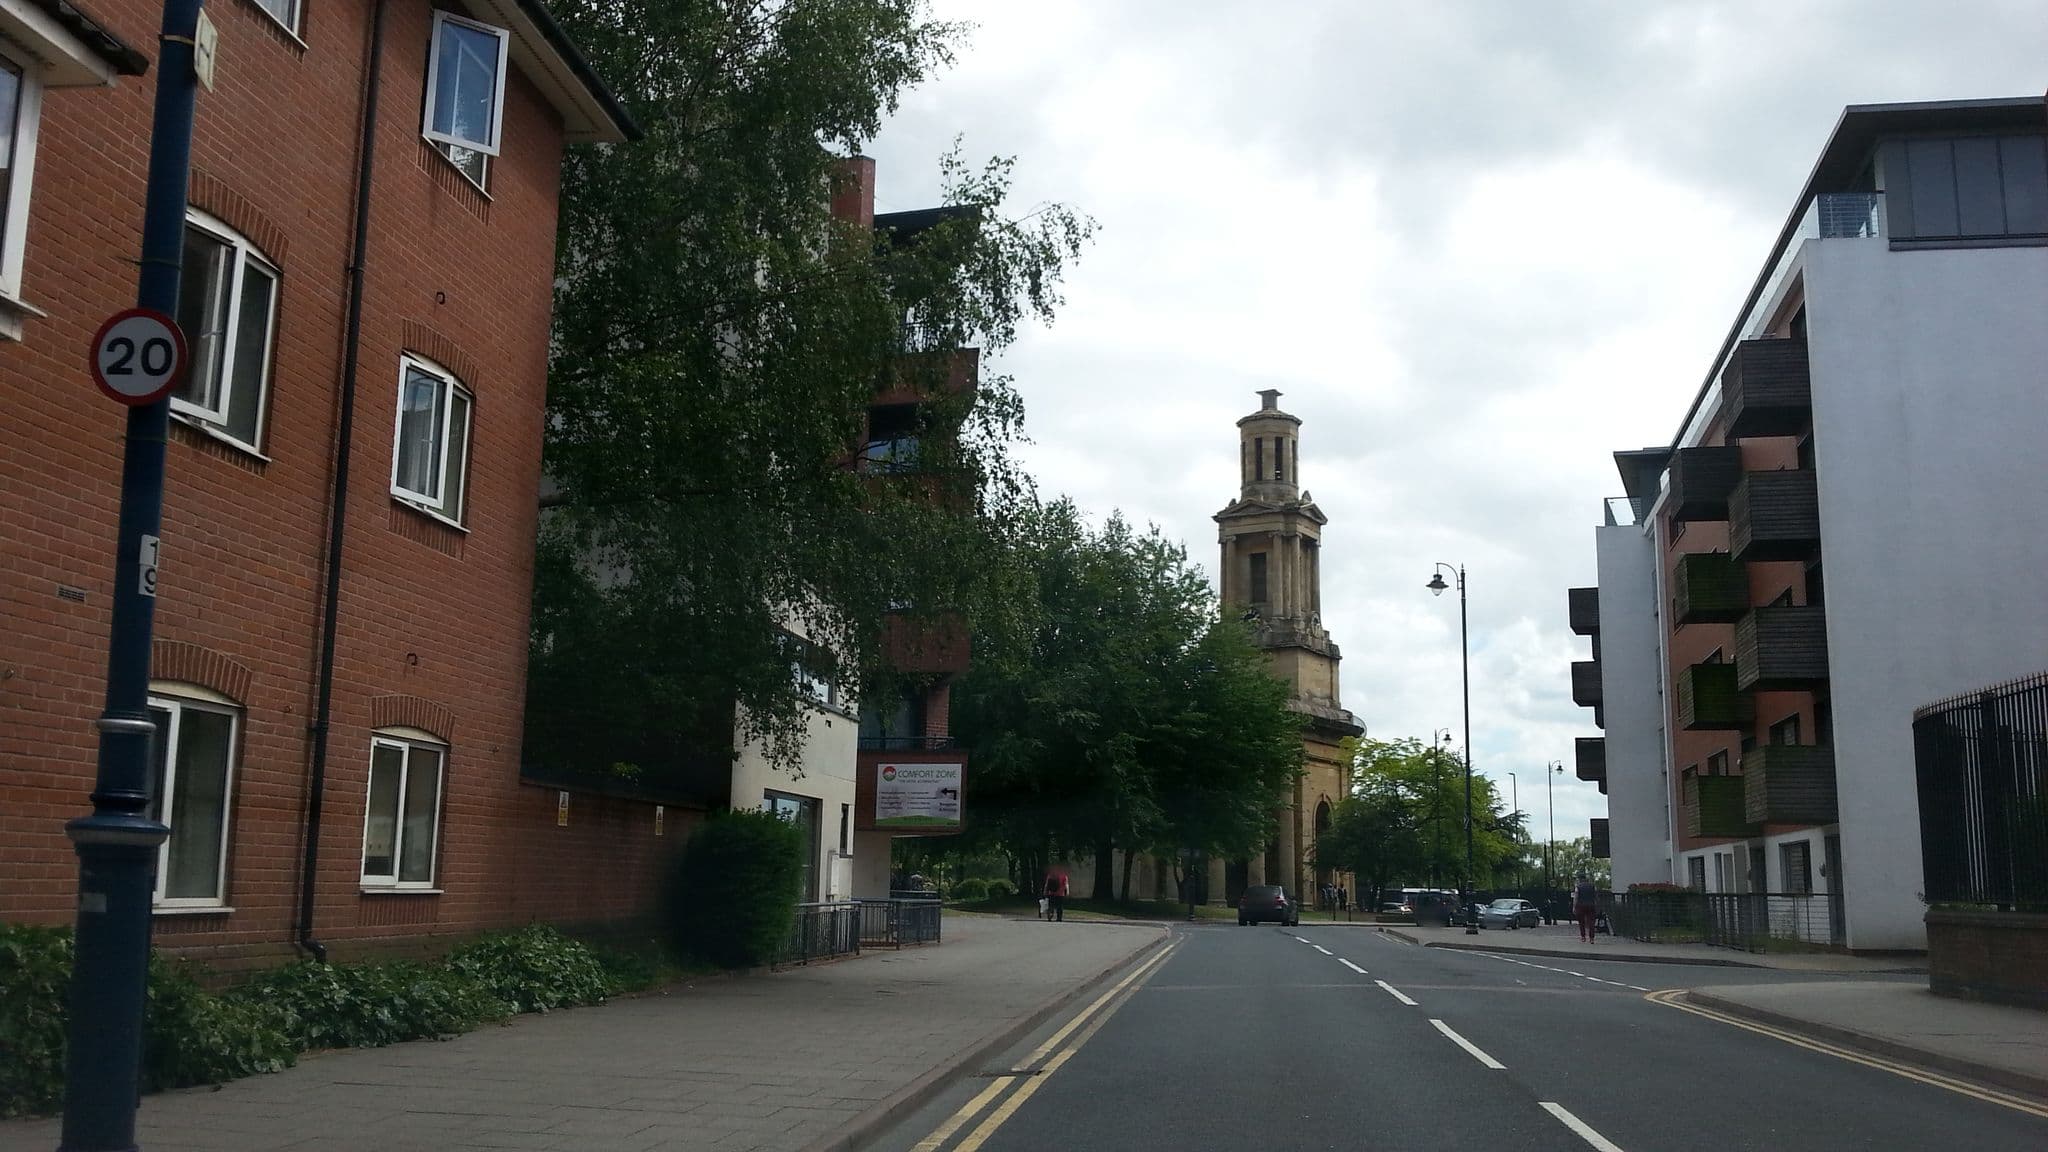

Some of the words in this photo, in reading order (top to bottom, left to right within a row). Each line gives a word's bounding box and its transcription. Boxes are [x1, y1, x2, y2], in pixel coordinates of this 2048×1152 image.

[106, 337, 173, 377] 20
[897, 769, 933, 778] COMFORT
[936, 769, 956, 778] ZONE
